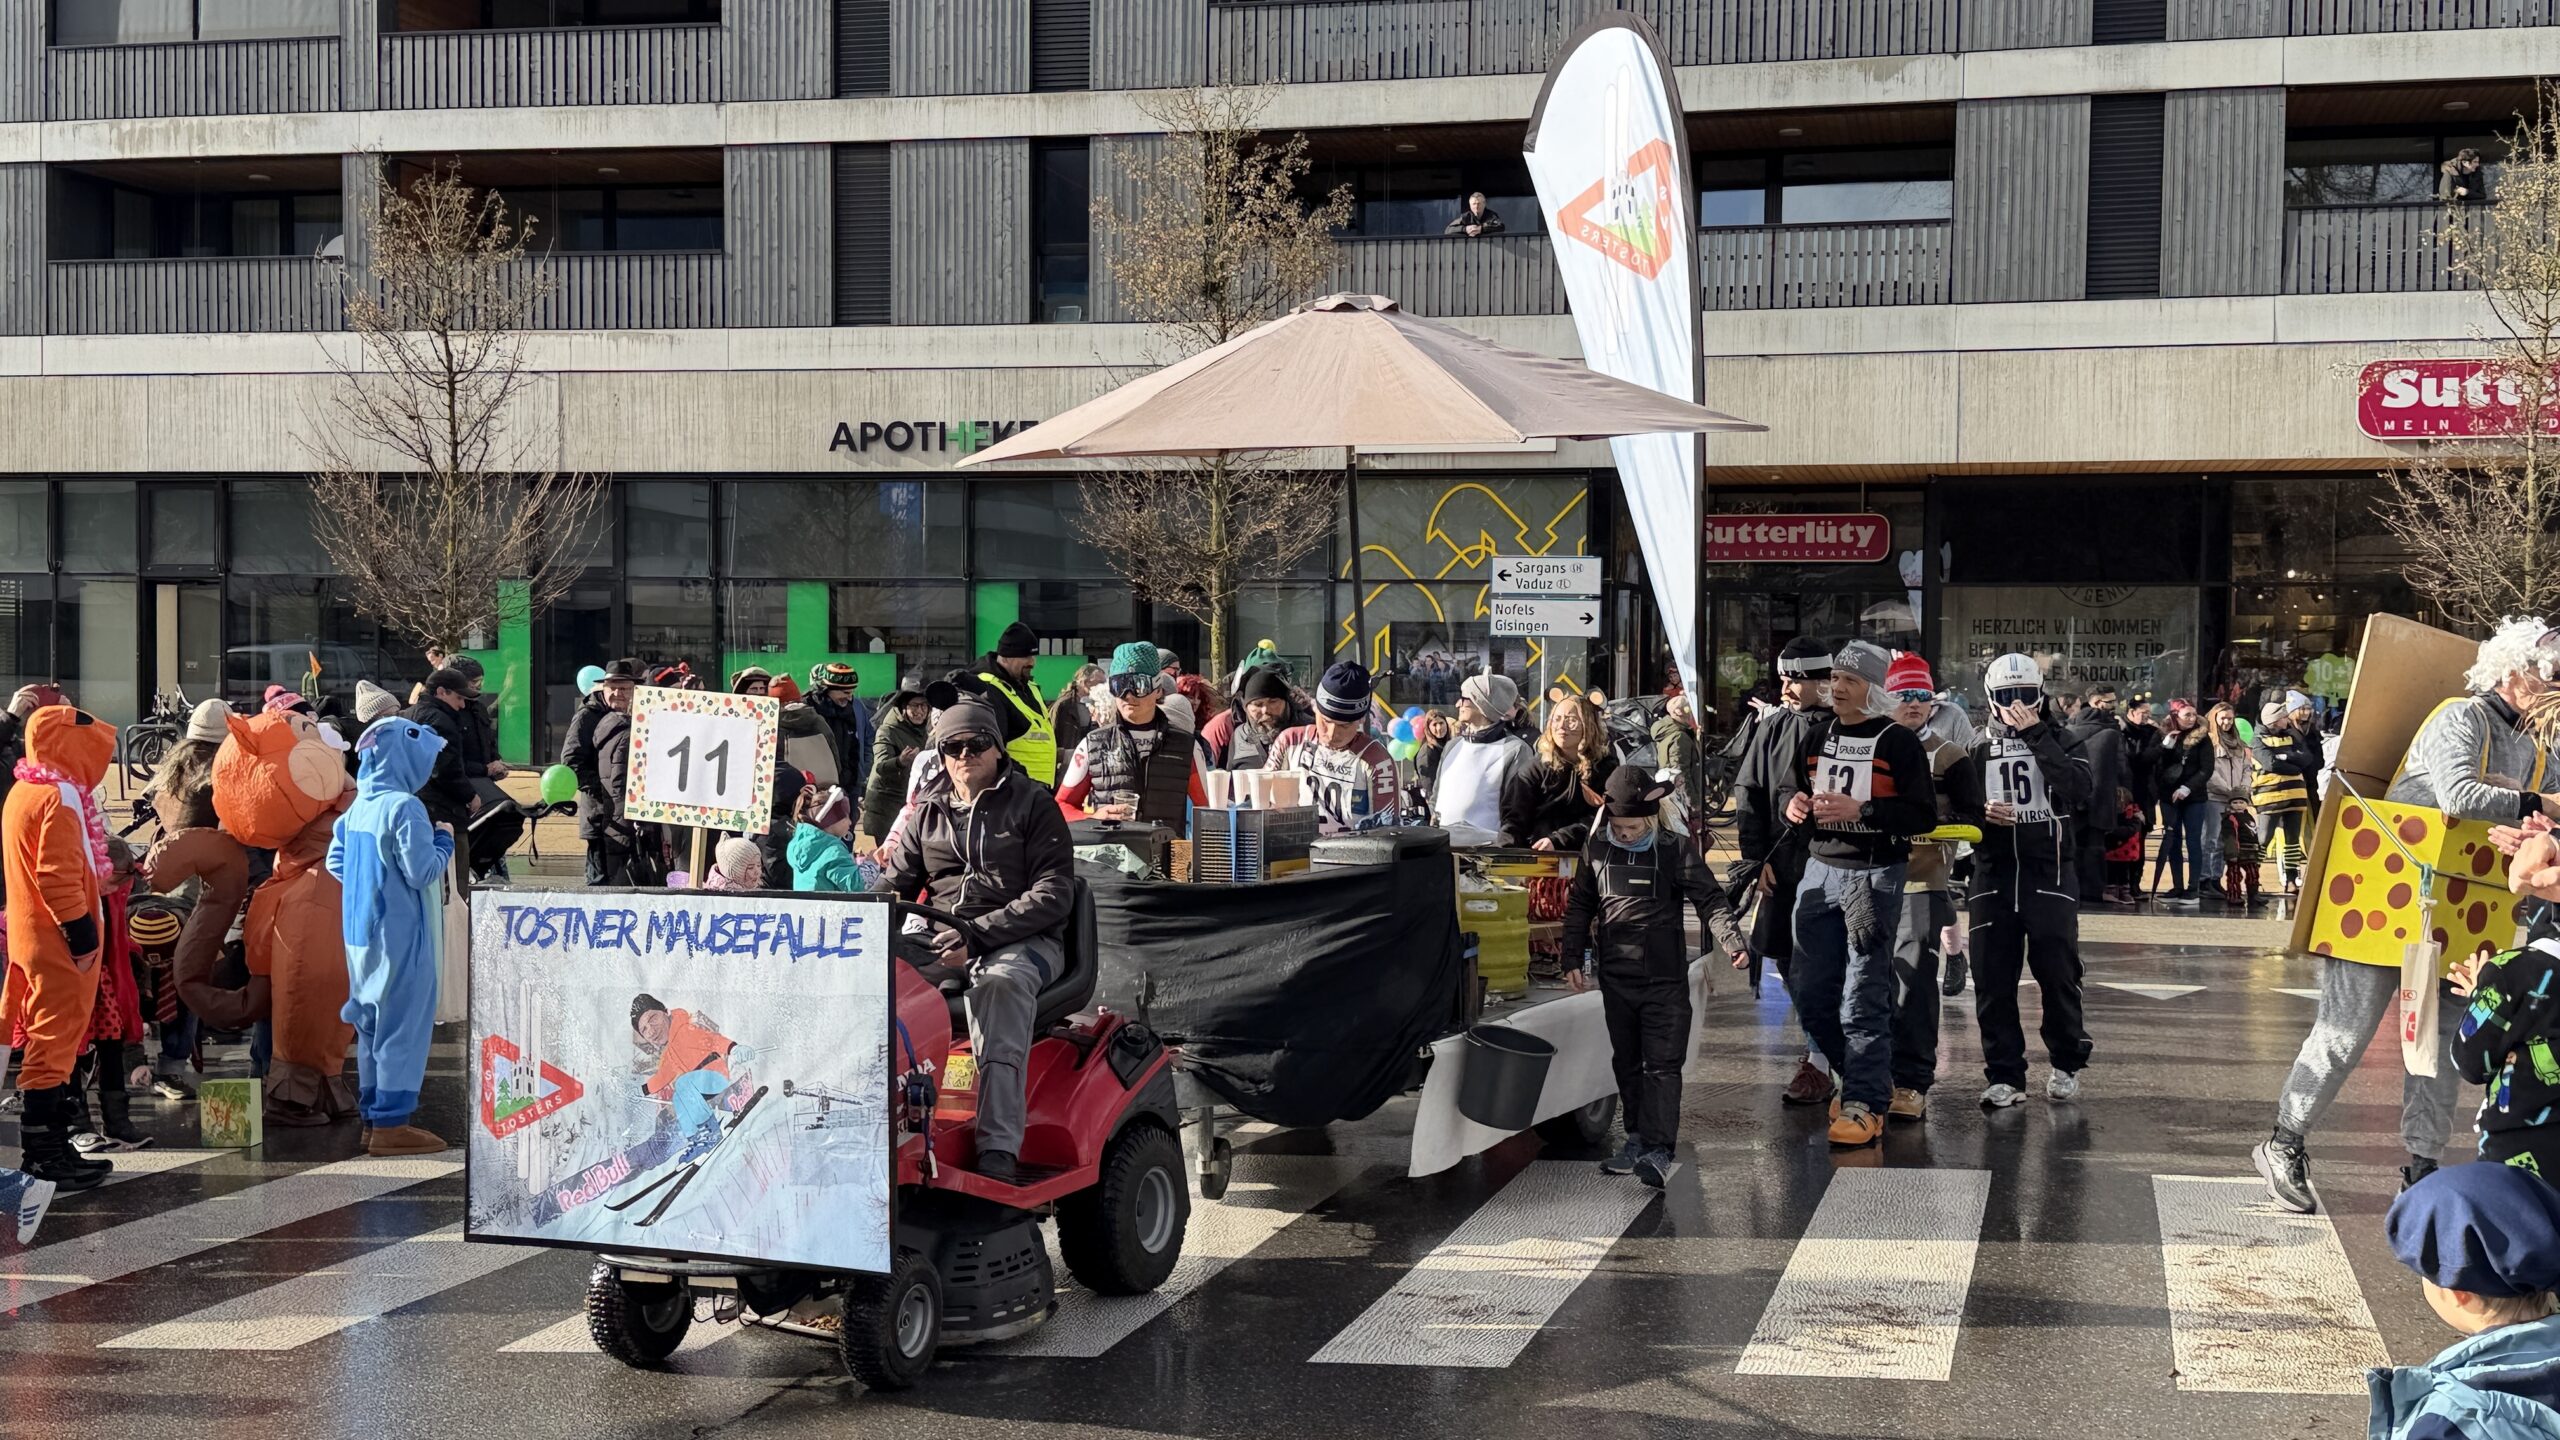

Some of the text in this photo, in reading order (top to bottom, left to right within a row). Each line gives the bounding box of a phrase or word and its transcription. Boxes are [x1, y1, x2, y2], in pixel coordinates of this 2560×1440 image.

[2384, 420, 2449, 430] MEIN
[1515, 562, 1566, 575] Sargans
[1515, 578, 1553, 589] Vaduz
[1495, 604, 1535, 615] Nofels
[1495, 620, 1549, 633] Gisingen
[1972, 619, 2162, 635] HERZLICH WILLKOMMEN
[2135, 639, 2165, 658] FÜR
[667, 736, 729, 796] 11
[1998, 760, 2032, 805] 16
[499, 905, 863, 963] TOSTNER MAUSEFALLE
[499, 1094, 563, 1133] TOSTERS
